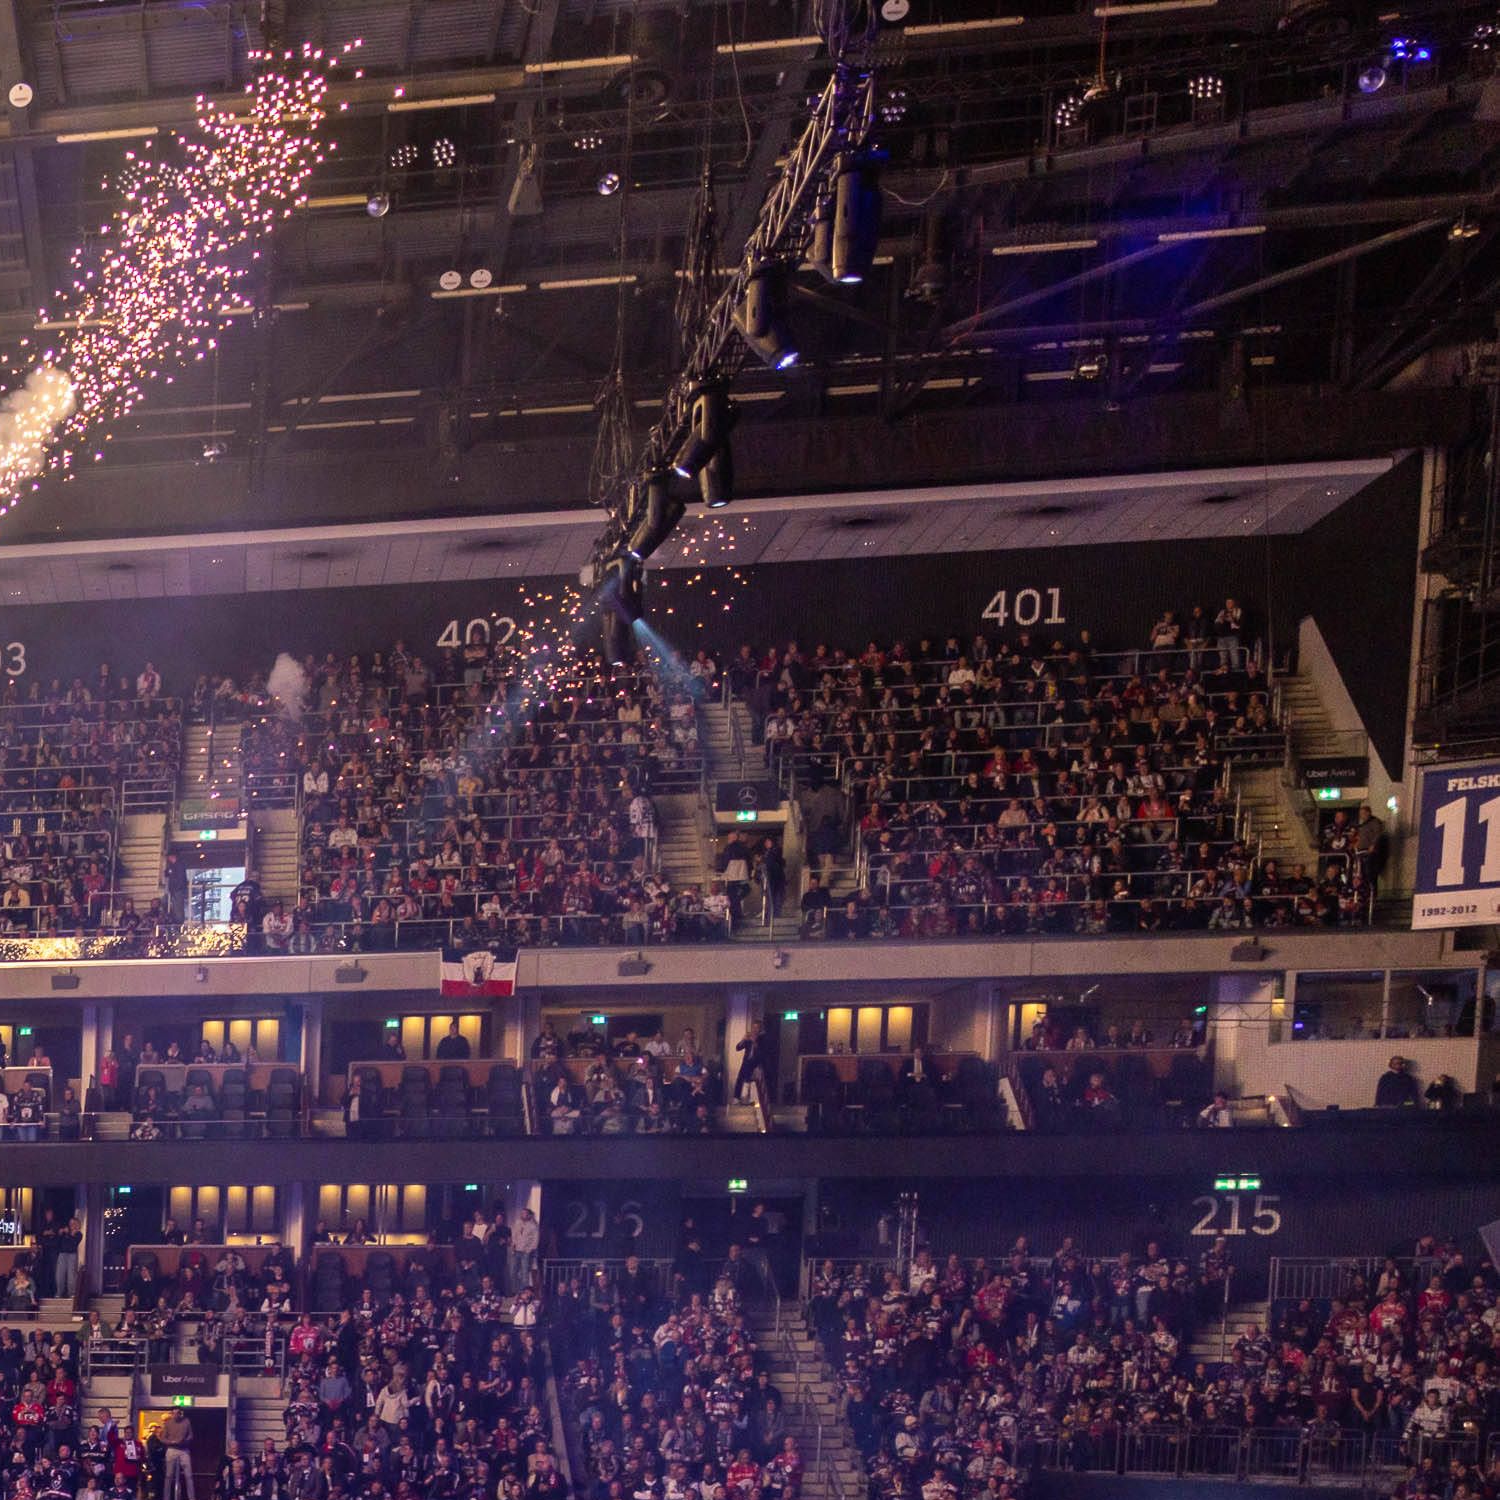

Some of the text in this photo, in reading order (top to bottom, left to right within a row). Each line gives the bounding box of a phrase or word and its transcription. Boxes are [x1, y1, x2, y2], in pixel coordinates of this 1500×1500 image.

[982, 587, 1066, 627] 401
[436, 617, 517, 648] 402
[1306, 767, 1357, 779] Uber Arena
[182, 809, 236, 824] GASAG
[1421, 903, 1478, 917] 1992-2012
[1190, 1195, 1282, 1237] 215
[162, 1375, 182, 1384] Uber
